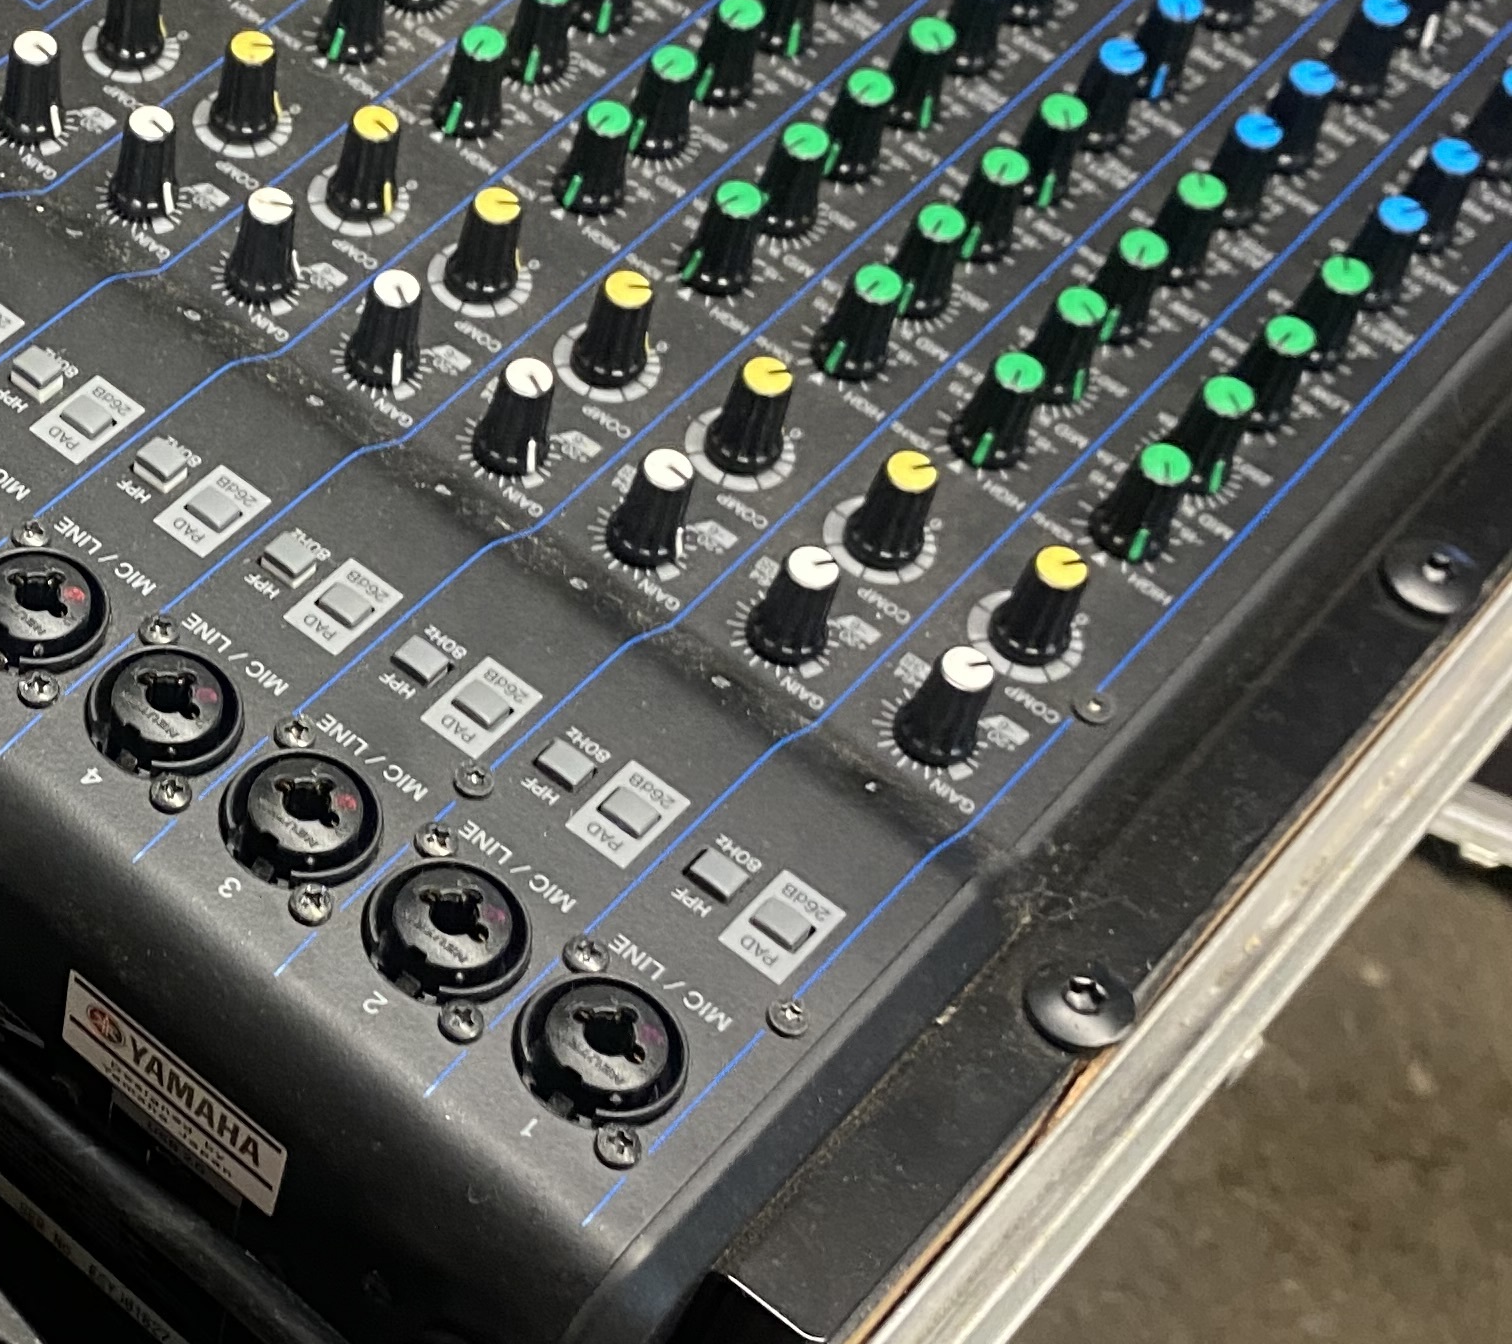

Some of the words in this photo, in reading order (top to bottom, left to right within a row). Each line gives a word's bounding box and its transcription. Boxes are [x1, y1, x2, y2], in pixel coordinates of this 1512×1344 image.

[22, 152, 58, 181] GAIN
[215, 161, 259, 189] COMP
[133, 230, 170, 260] GAIN
[332, 239, 377, 269] COMP
[251, 315, 289, 343] GAIN
[454, 320, 502, 352] COMP
[91, 386, 132, 417] 26dB
[374, 397, 413, 428] GAIN
[581, 405, 631, 438] COMP
[47, 426, 79, 451] PAD
[116, 478, 151, 504] HPF
[215, 475, 257, 506] 26dB
[502, 486, 543, 517] GAIN
[716, 494, 768, 529] COMP
[54, 515, 102, 555] LINE
[172, 516, 205, 543] PAD
[115, 561, 157, 597] MIC
[244, 572, 280, 600] HPF
[346, 569, 389, 603] 26dB
[639, 578, 680, 612] GAIN
[857, 587, 911, 624] COMP
[181, 612, 232, 652] LINE
[303, 613, 337, 640] PAD
[424, 624, 467, 660] 80Hz
[245, 659, 289, 696] MIC
[379, 671, 416, 699] HPF
[484, 668, 530, 704] 26dB
[781, 677, 824, 711] GAIN
[1005, 686, 1060, 723] COMP
[316, 714, 369, 755] LINE
[441, 714, 476, 743] PAD
[565, 725, 611, 762] 80Hz
[81, 768, 103, 785] 4
[382, 764, 428, 801] MIC
[520, 775, 559, 805] HPF
[629, 772, 675, 810] 26dB
[930, 779, 976, 814] GAIN
[458, 820, 513, 865] LINE
[586, 821, 623, 852] PAD
[715, 833, 762, 874] 80Hz
[218, 878, 241, 898] 3
[528, 873, 577, 913] MIC
[670, 885, 712, 917] HPF
[782, 883, 831, 922] 26dB
[608, 933, 666, 980] LINE
[740, 934, 779, 967] PAD
[362, 990, 388, 1014] 2
[682, 990, 733, 1032] MIC
[129, 1036, 260, 1167] YAMAHA
[520, 1118, 538, 1137] 1
